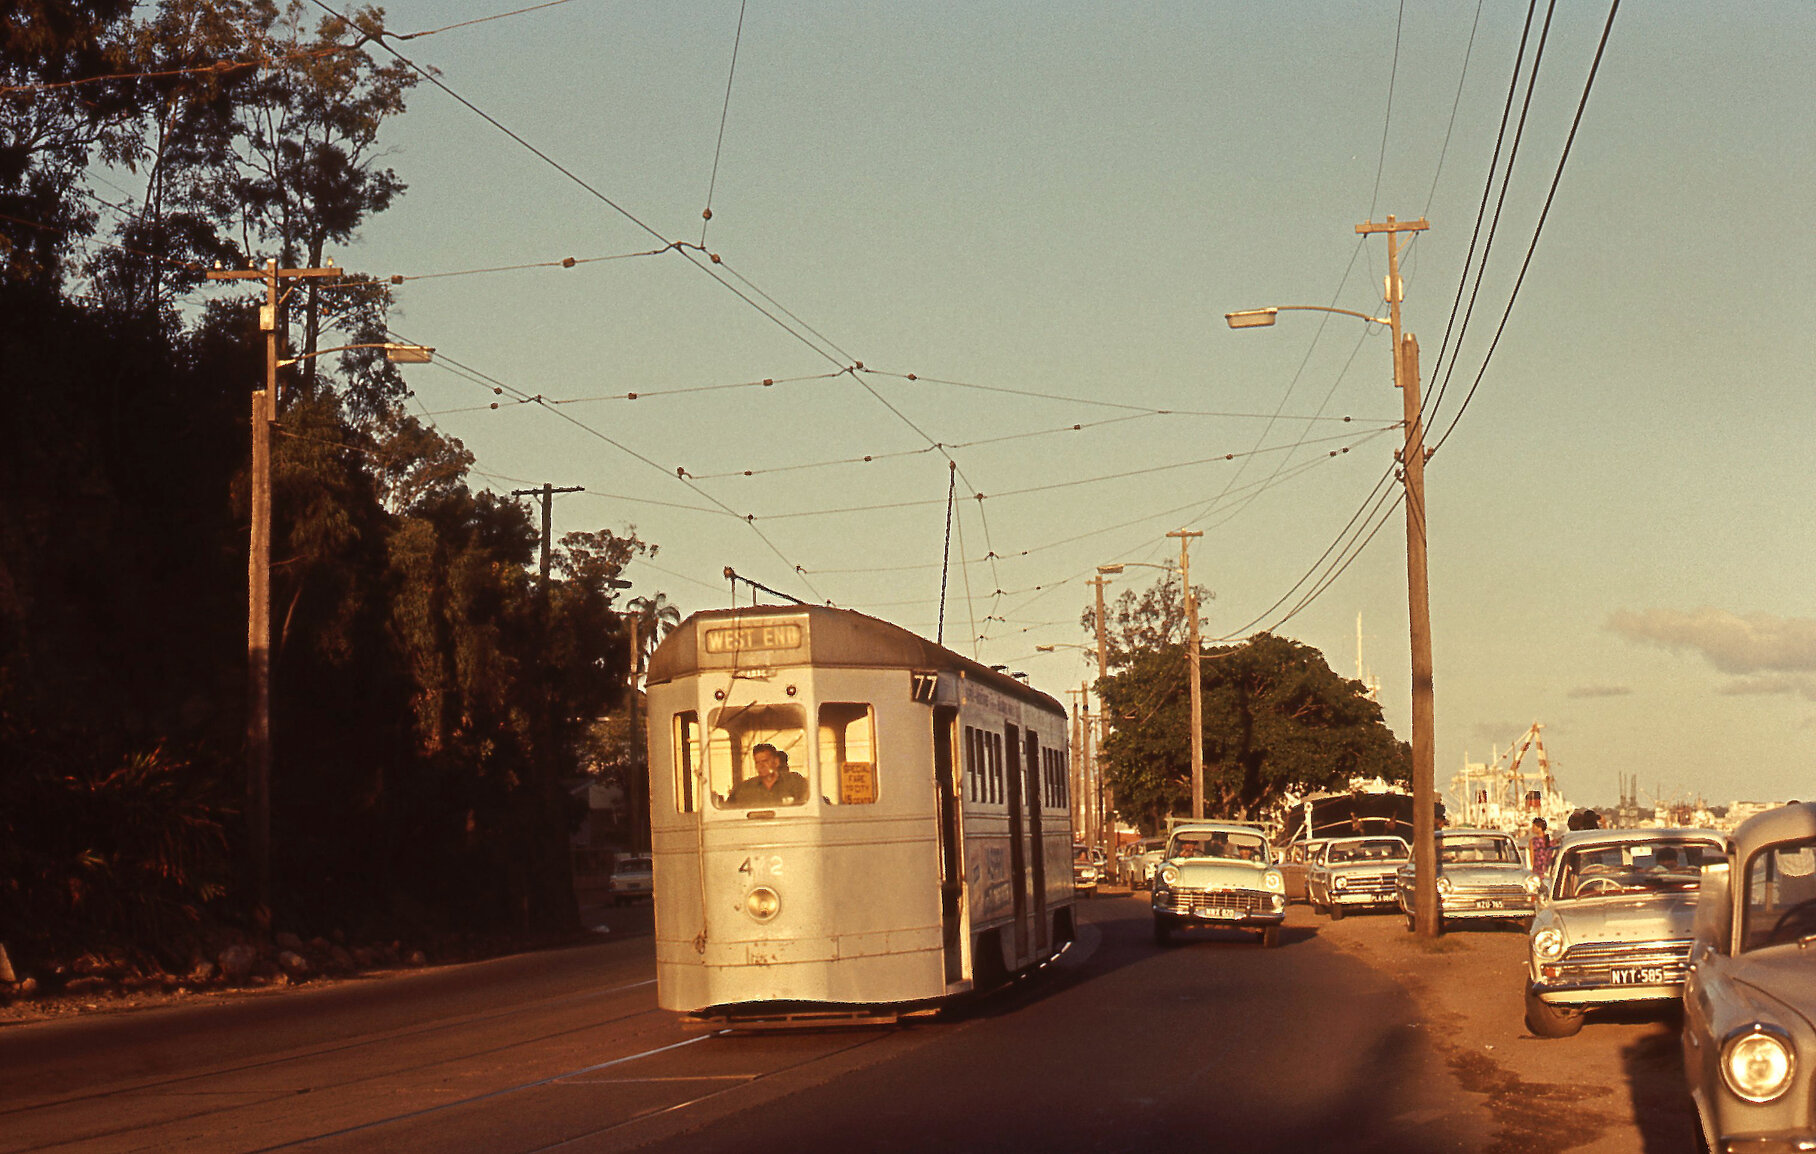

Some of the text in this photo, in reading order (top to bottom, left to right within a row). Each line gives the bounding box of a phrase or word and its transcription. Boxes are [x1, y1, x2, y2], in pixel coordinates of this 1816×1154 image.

[707, 625, 799, 651] WEST END
[914, 674, 938, 700] 77
